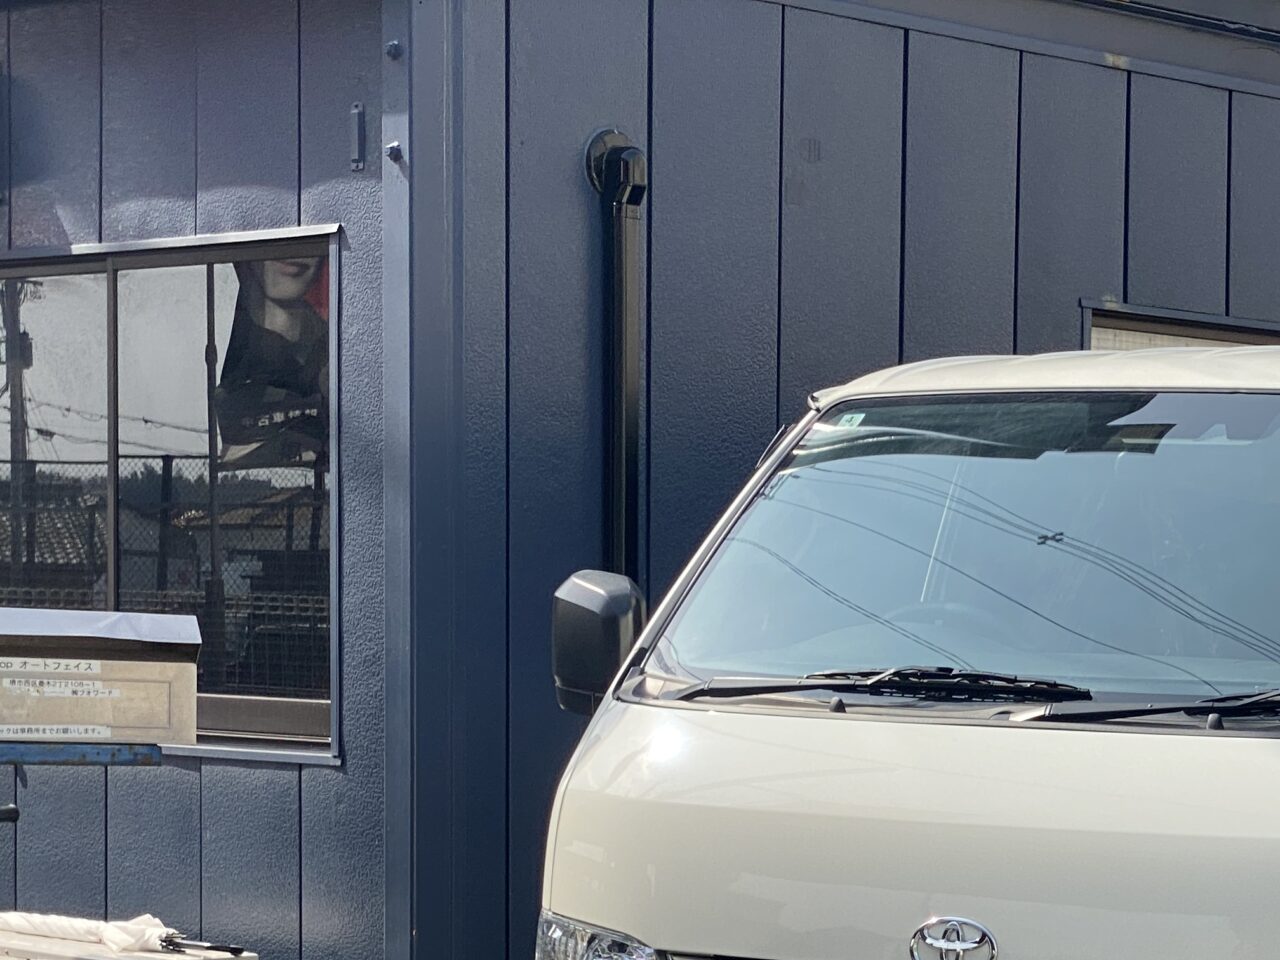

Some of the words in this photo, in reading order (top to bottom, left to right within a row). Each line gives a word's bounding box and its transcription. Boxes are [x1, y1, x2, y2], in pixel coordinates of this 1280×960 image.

[19, 660, 93, 671] オートフェイス
